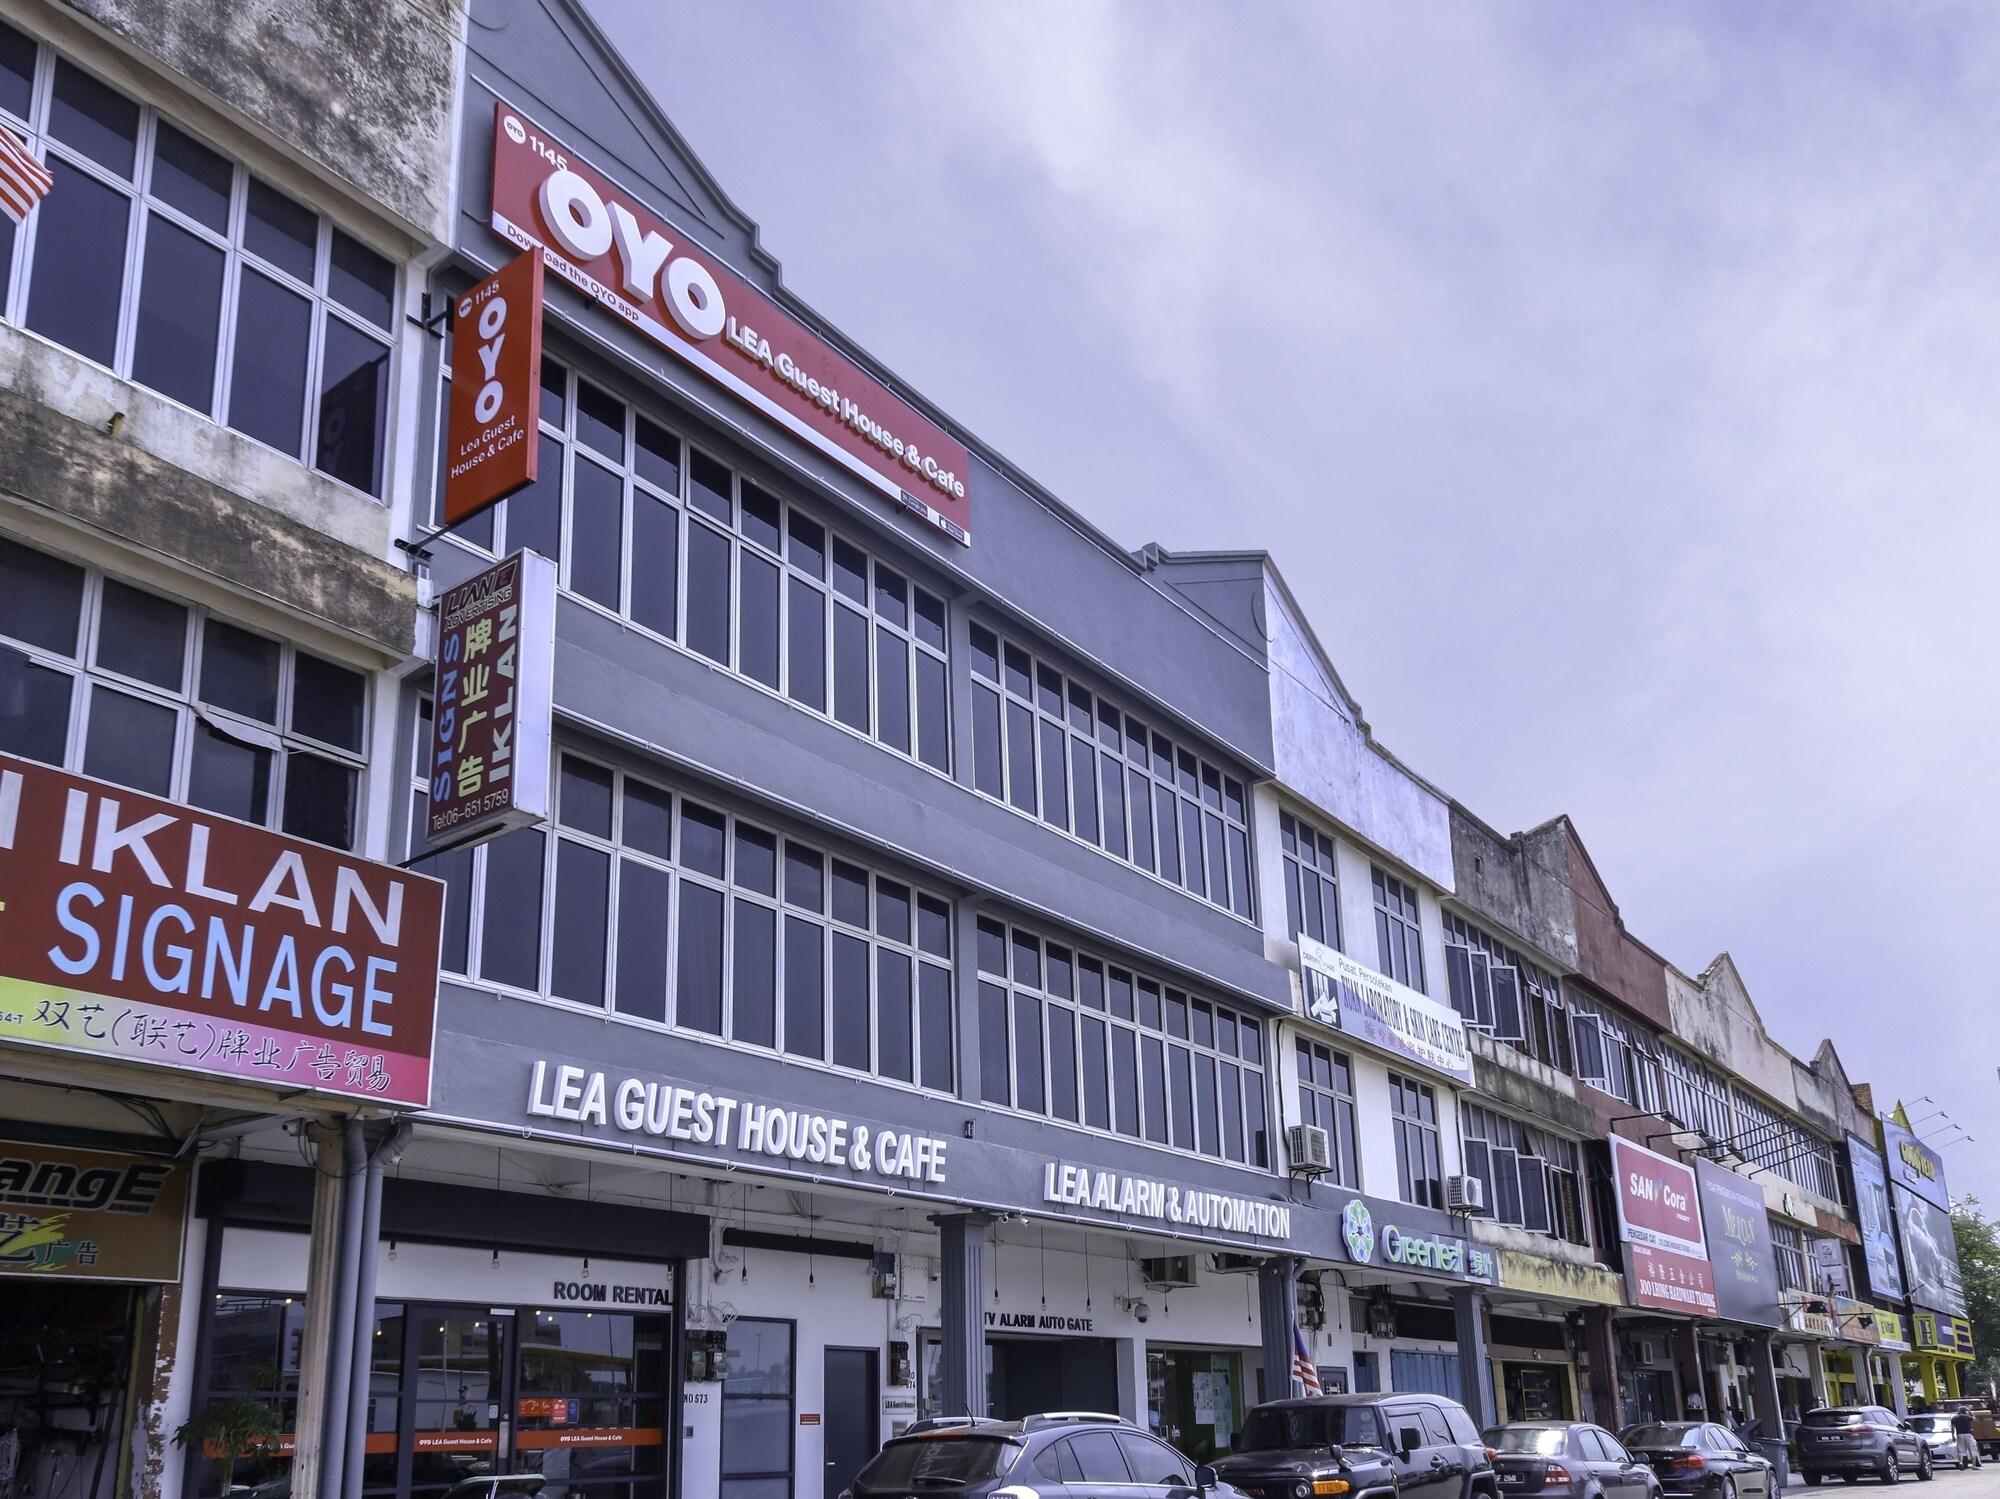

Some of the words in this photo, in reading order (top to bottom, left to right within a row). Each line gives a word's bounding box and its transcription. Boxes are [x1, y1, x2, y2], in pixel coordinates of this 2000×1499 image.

[529, 135, 569, 172] 1145
[507, 225, 568, 275] Dowoad
[568, 267, 588, 287] the
[590, 281, 617, 305] OYO
[618, 301, 640, 322] app
[538, 169, 726, 341] OYO
[474, 279, 500, 305] 1145
[474, 296, 508, 424] OYO
[726, 315, 774, 367] LEA
[774, 352, 841, 414] Guest
[840, 397, 905, 457] House
[904, 444, 922, 472] &
[920, 456, 965, 499] Cafe
[451, 450, 486, 480] House
[486, 443, 496, 458] &
[497, 427, 524, 451] Cafe
[460, 436, 480, 457] Lea
[482, 414, 516, 446] Guest
[434, 632, 460, 802] SIGNS
[457, 617, 492, 798] 牌业广告
[488, 603, 518, 783] IKLAN
[483, 788, 509, 812] 5759
[58, 787, 405, 947] IKLAN
[47, 881, 399, 1038] SIGNAGE
[1425, 1014, 1443, 1050] CARE
[526, 1060, 608, 1126] LEA
[614, 1078, 737, 1146] GUEST
[737, 1102, 848, 1166] HOUSE
[848, 1124, 871, 1172] &
[875, 1129, 948, 1184] CAFE
[1044, 1162, 1091, 1206] LEA
[1090, 1171, 1165, 1219] ALARM
[1165, 1186, 1183, 1223] &
[1182, 1189, 1291, 1240] AUTOMATION
[1630, 1172, 1653, 1201] SAN
[1663, 1184, 1686, 1212] Cora
[553, 1281, 607, 1302] ROOM
[612, 1285, 674, 1306] RENTAL
[1640, 1278, 1652, 1296] JOO
[1000, 1312, 1036, 1328] ALARM
[1039, 1315, 1065, 1330] AUTO
[1067, 1317, 1093, 1332] GATE
[694, 1393, 709, 1404] 573
[459, 1437, 475, 1445] House
